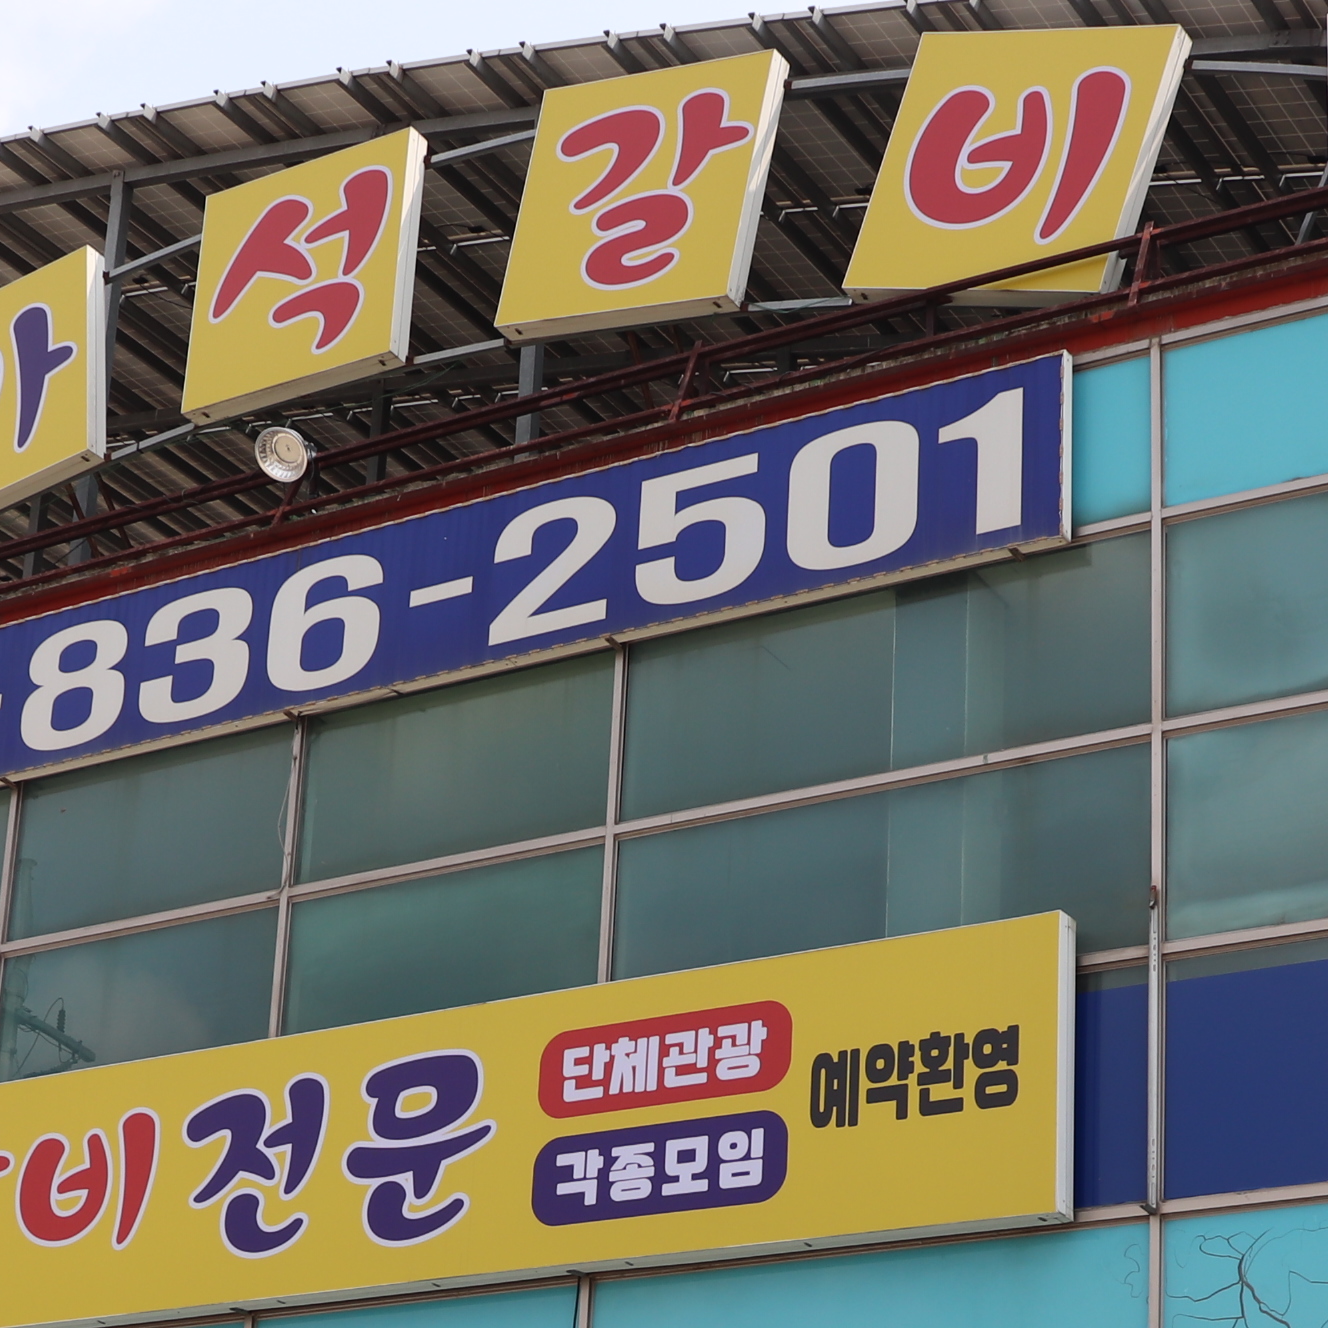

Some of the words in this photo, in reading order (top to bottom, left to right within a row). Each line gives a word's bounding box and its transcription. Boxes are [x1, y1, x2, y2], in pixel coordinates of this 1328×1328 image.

[561, 1019, 769, 1104] 단체관광
[809, 1023, 1021, 1130] 예약환영
[554, 1127, 767, 1207] 각종모임
